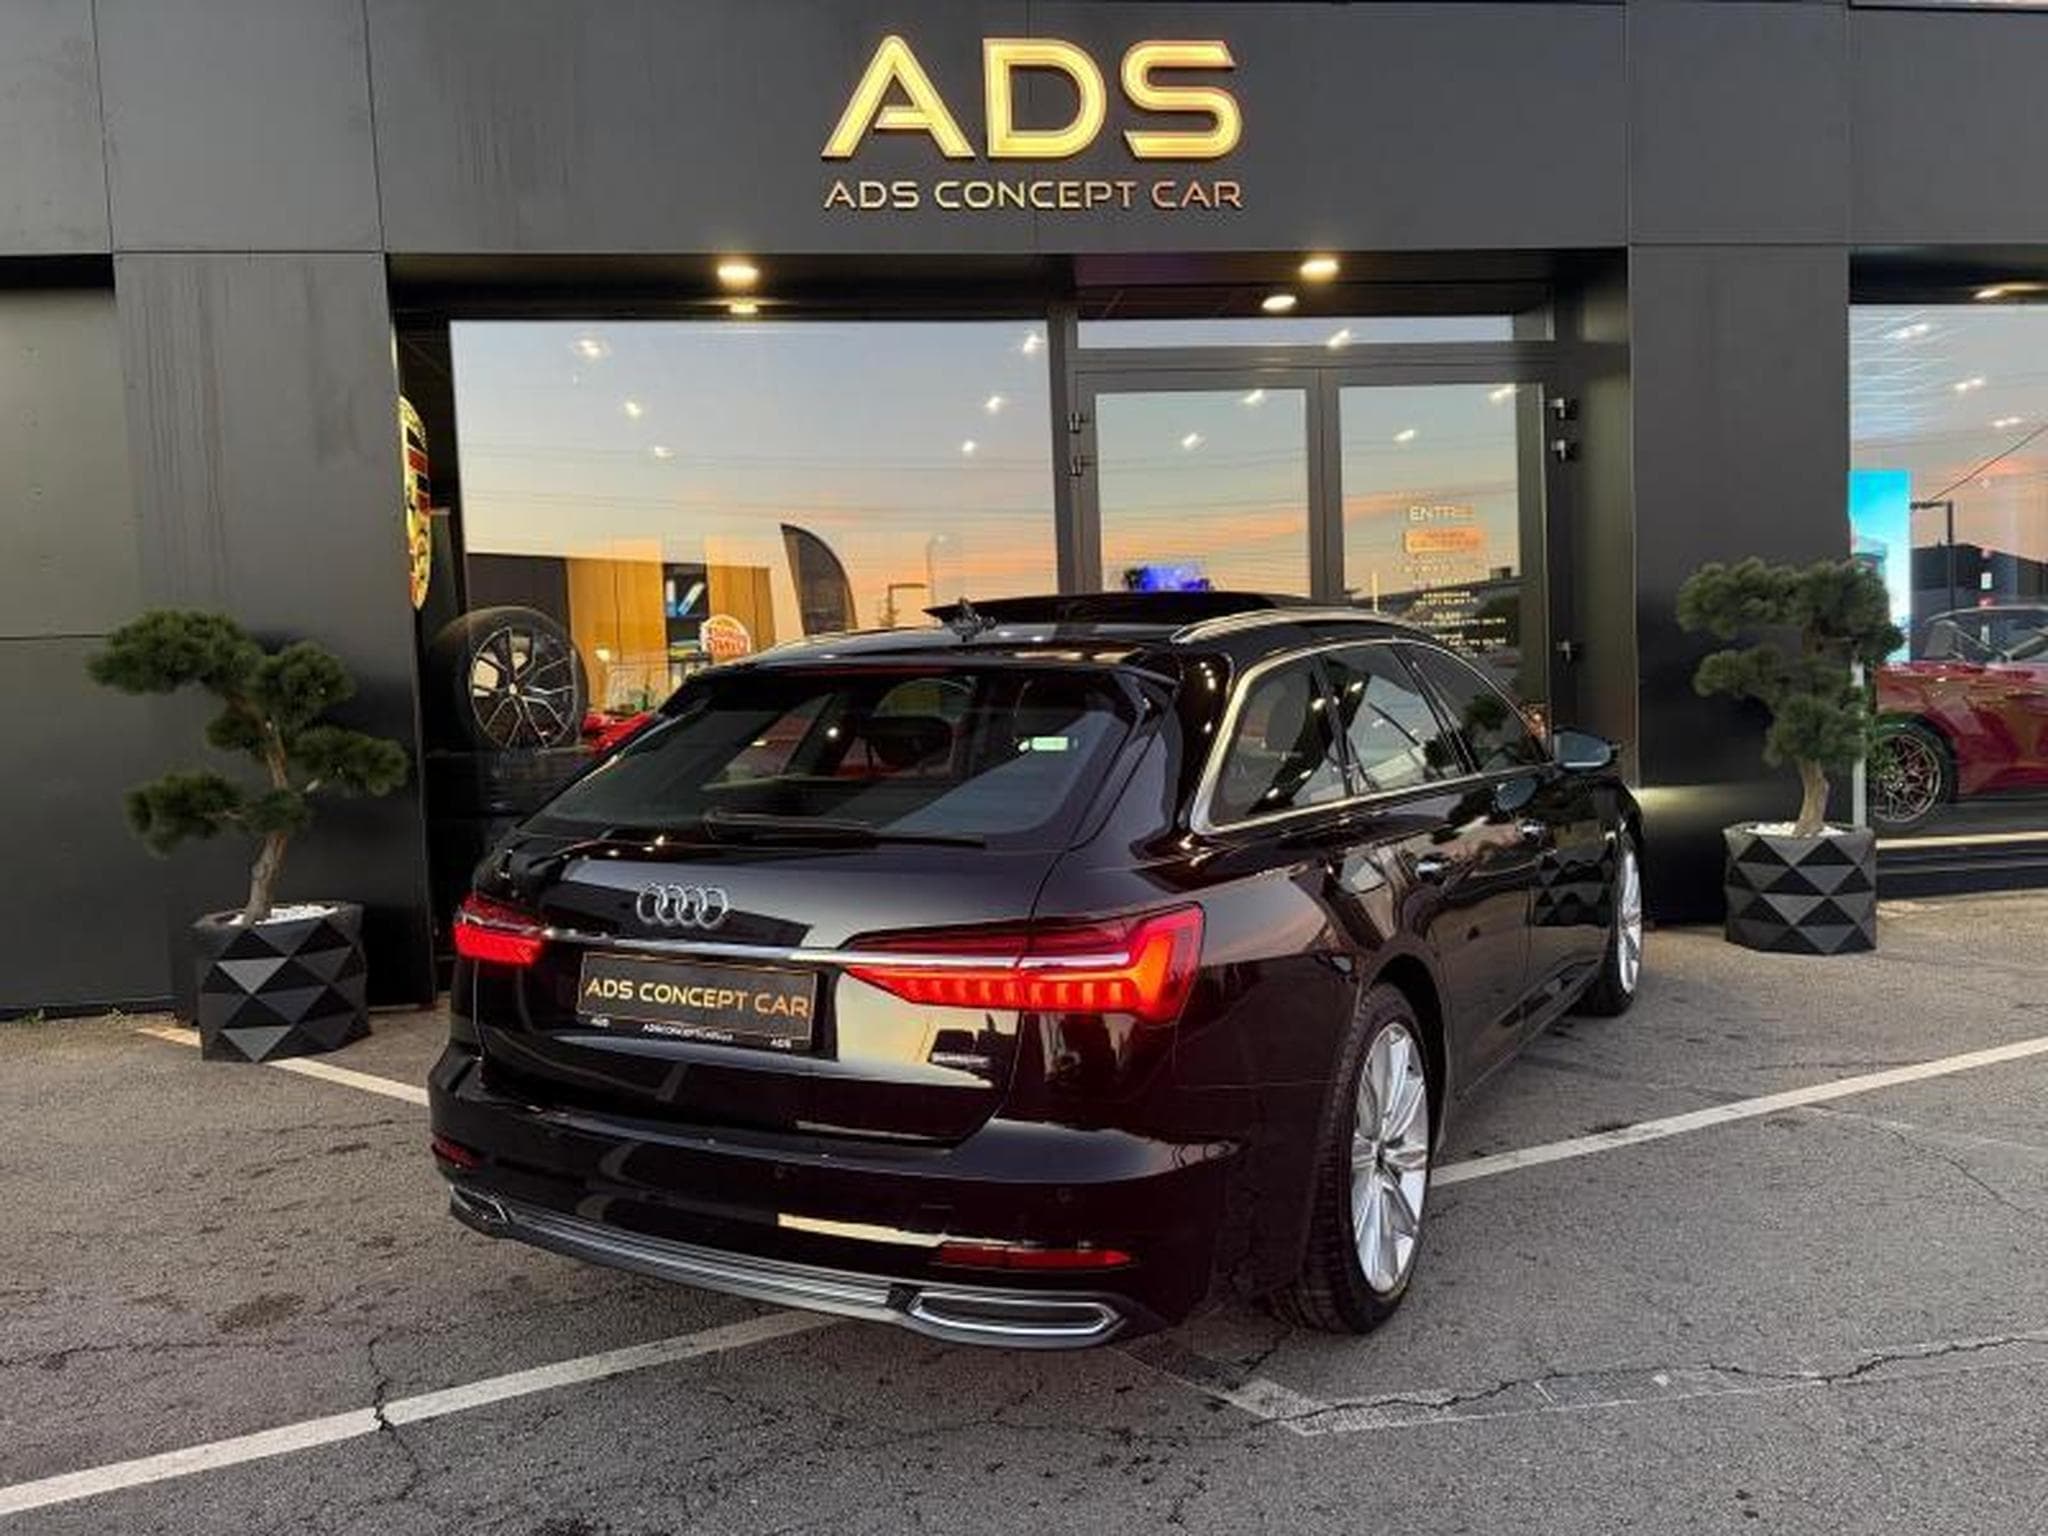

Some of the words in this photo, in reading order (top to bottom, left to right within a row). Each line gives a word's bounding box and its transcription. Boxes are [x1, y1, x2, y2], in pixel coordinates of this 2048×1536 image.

[820, 35, 1243, 160] ADS
[823, 180, 920, 210] ADS
[934, 180, 1137, 210] CONCEPT
[1151, 180, 1244, 210] CAR
[585, 977, 634, 1000] ADS
[639, 982, 749, 1012] CONCEPT
[754, 992, 809, 1019] CAR
